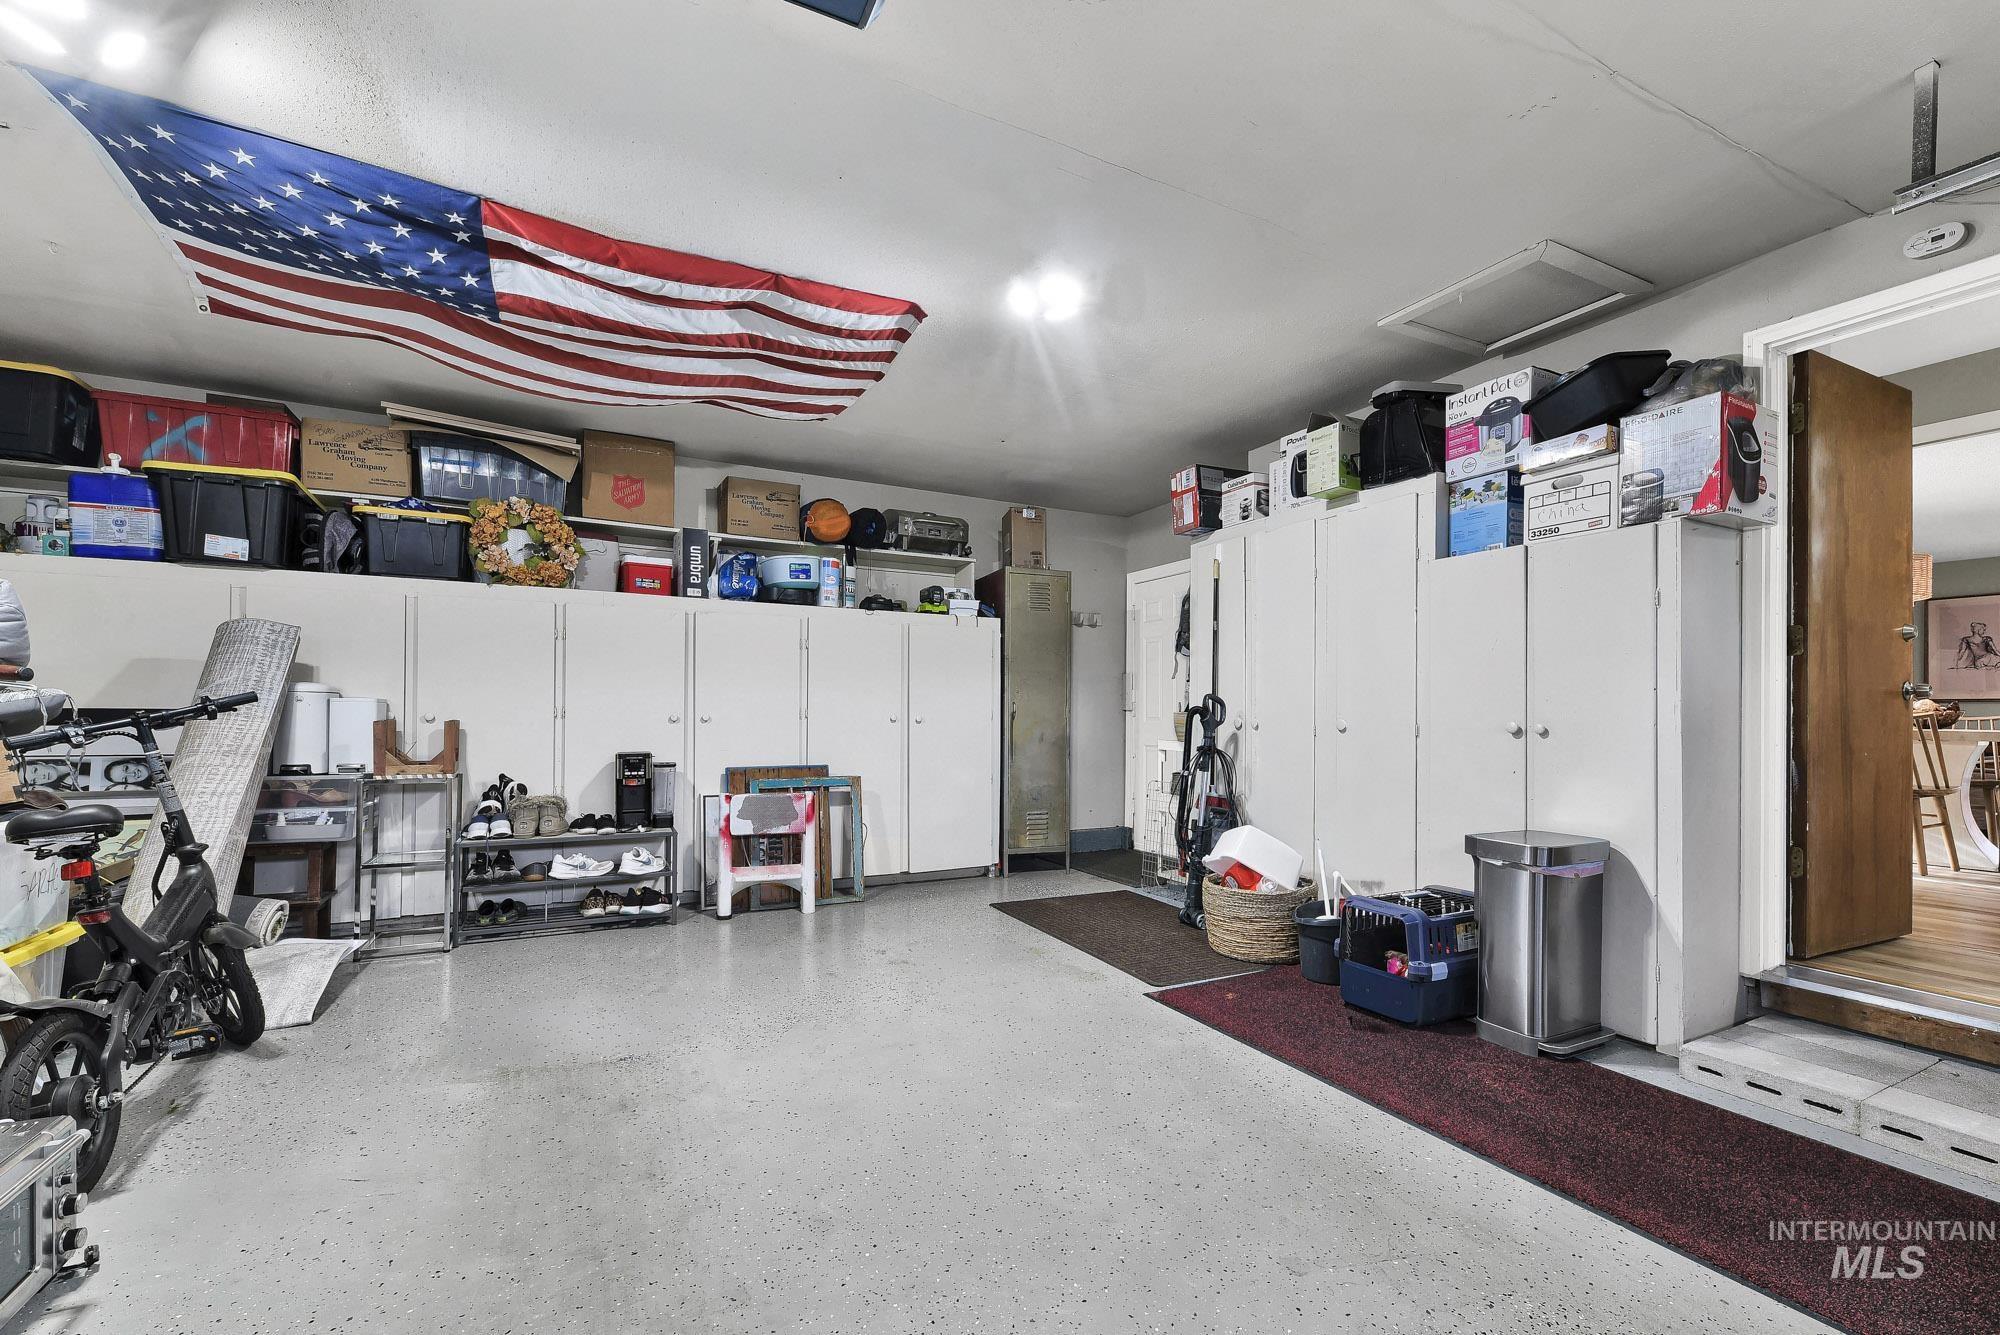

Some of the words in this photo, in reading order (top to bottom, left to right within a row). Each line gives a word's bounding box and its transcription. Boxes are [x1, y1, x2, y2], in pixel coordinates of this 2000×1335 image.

[1449, 386, 1488, 411] Instant
[1491, 377, 1512, 396] Pot
[1448, 411, 1468, 422] NOVA
[308, 438, 347, 449] Lawrence
[322, 446, 356, 456] Graham
[336, 453, 366, 464] Moving
[350, 461, 388, 473] Company
[618, 479, 631, 488] THE
[613, 482, 642, 499] SALVATION
[623, 492, 641, 505] ARMY
[732, 492, 759, 501] Lawrence
[741, 498, 764, 506] Graham
[751, 505, 771, 513] Moving
[1537, 503, 1591, 523] China
[760, 511, 785, 520] Company
[1530, 526, 1560, 539] 33250
[690, 545, 704, 584] umbra
